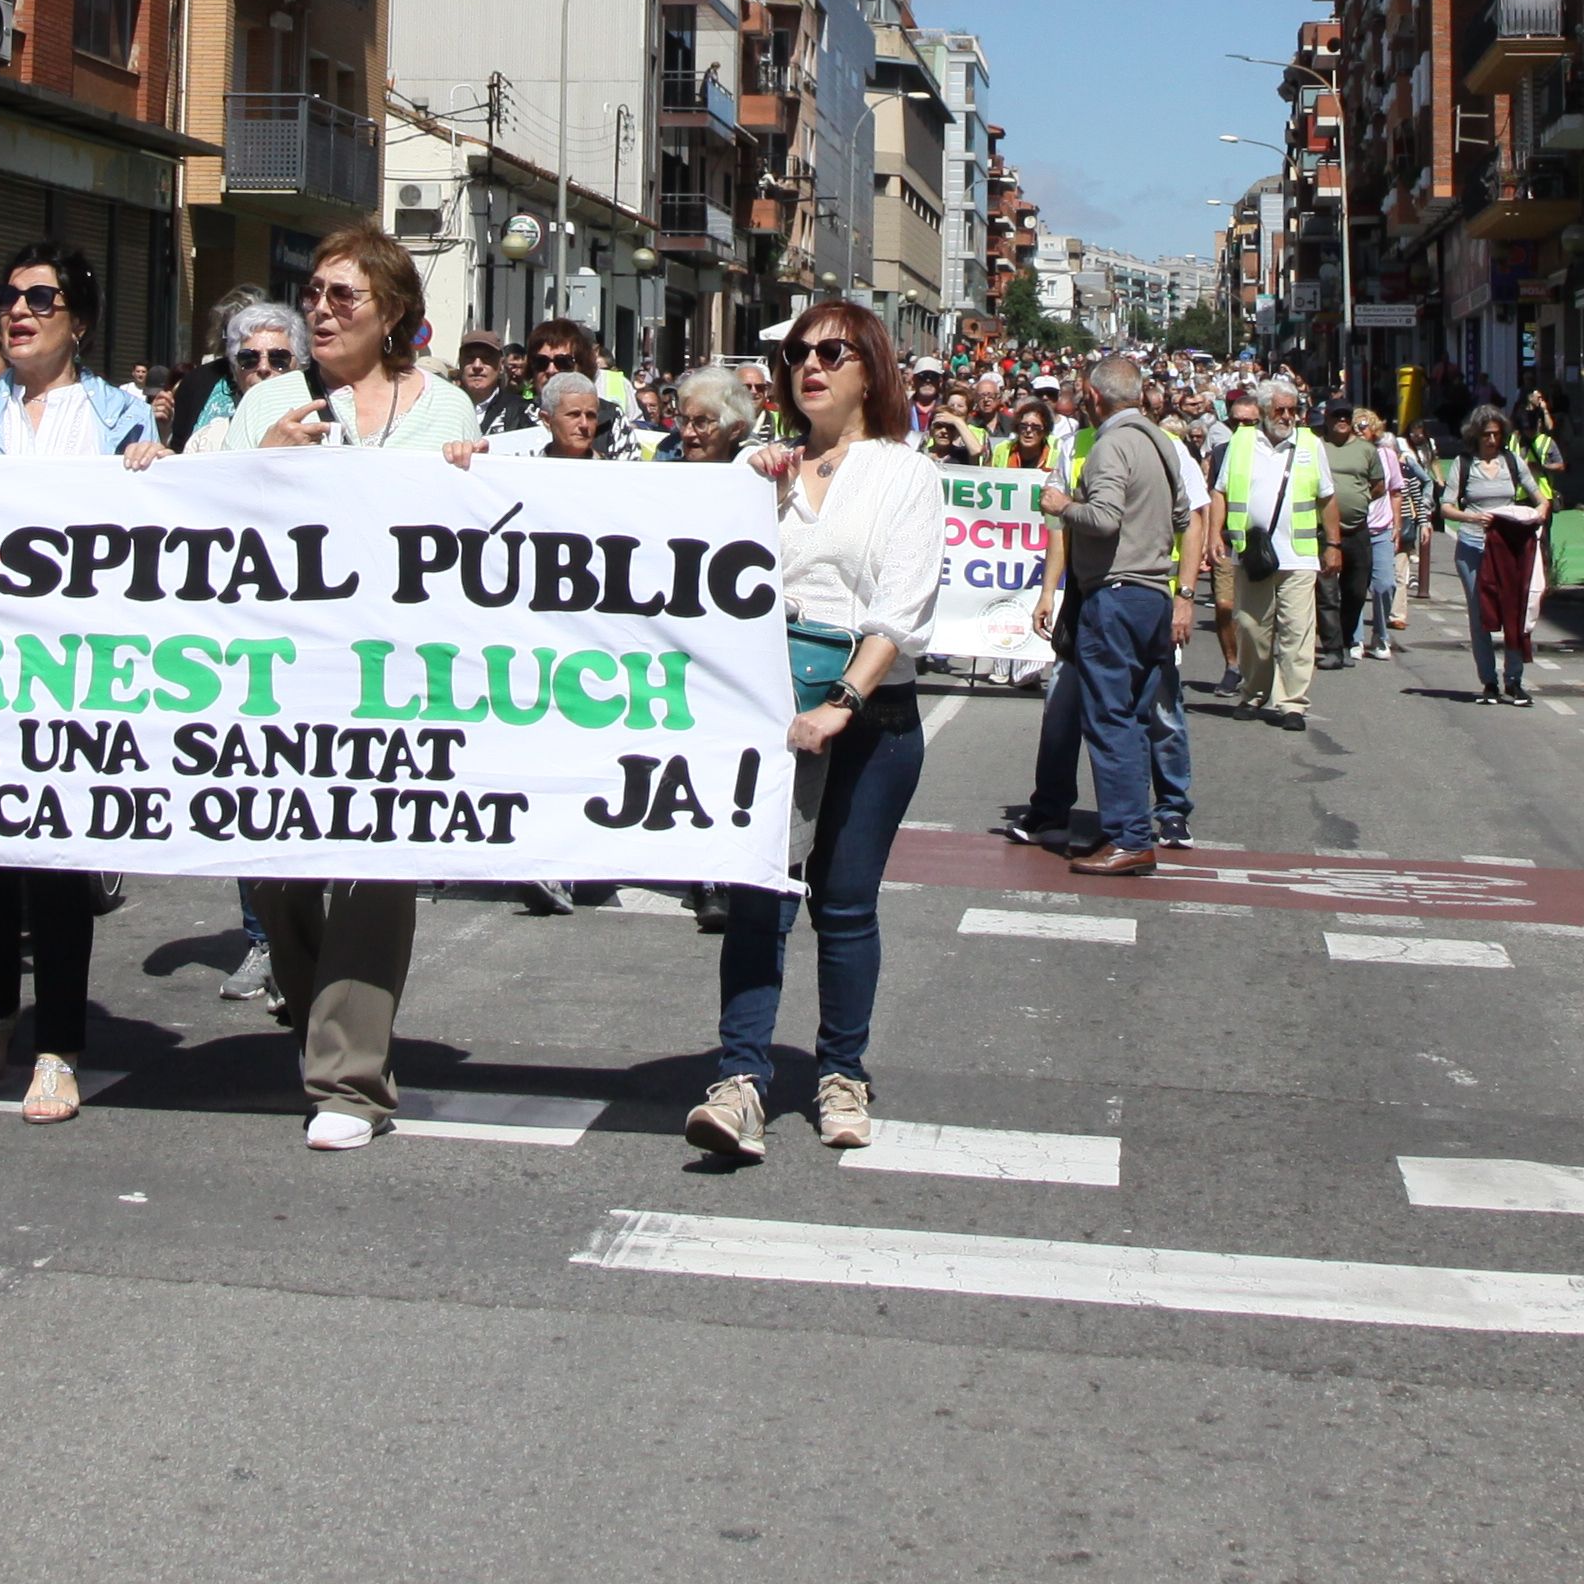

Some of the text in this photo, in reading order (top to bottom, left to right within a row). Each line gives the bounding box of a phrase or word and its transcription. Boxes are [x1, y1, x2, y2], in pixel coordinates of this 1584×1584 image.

[390, 499, 775, 619] PÚBLIC
[353, 641, 694, 730] LLUCH
[20, 720, 148, 775] UNA
[173, 724, 465, 782] SANITAT
[87, 787, 171, 840] DE
[190, 788, 528, 844] QUALITAT
